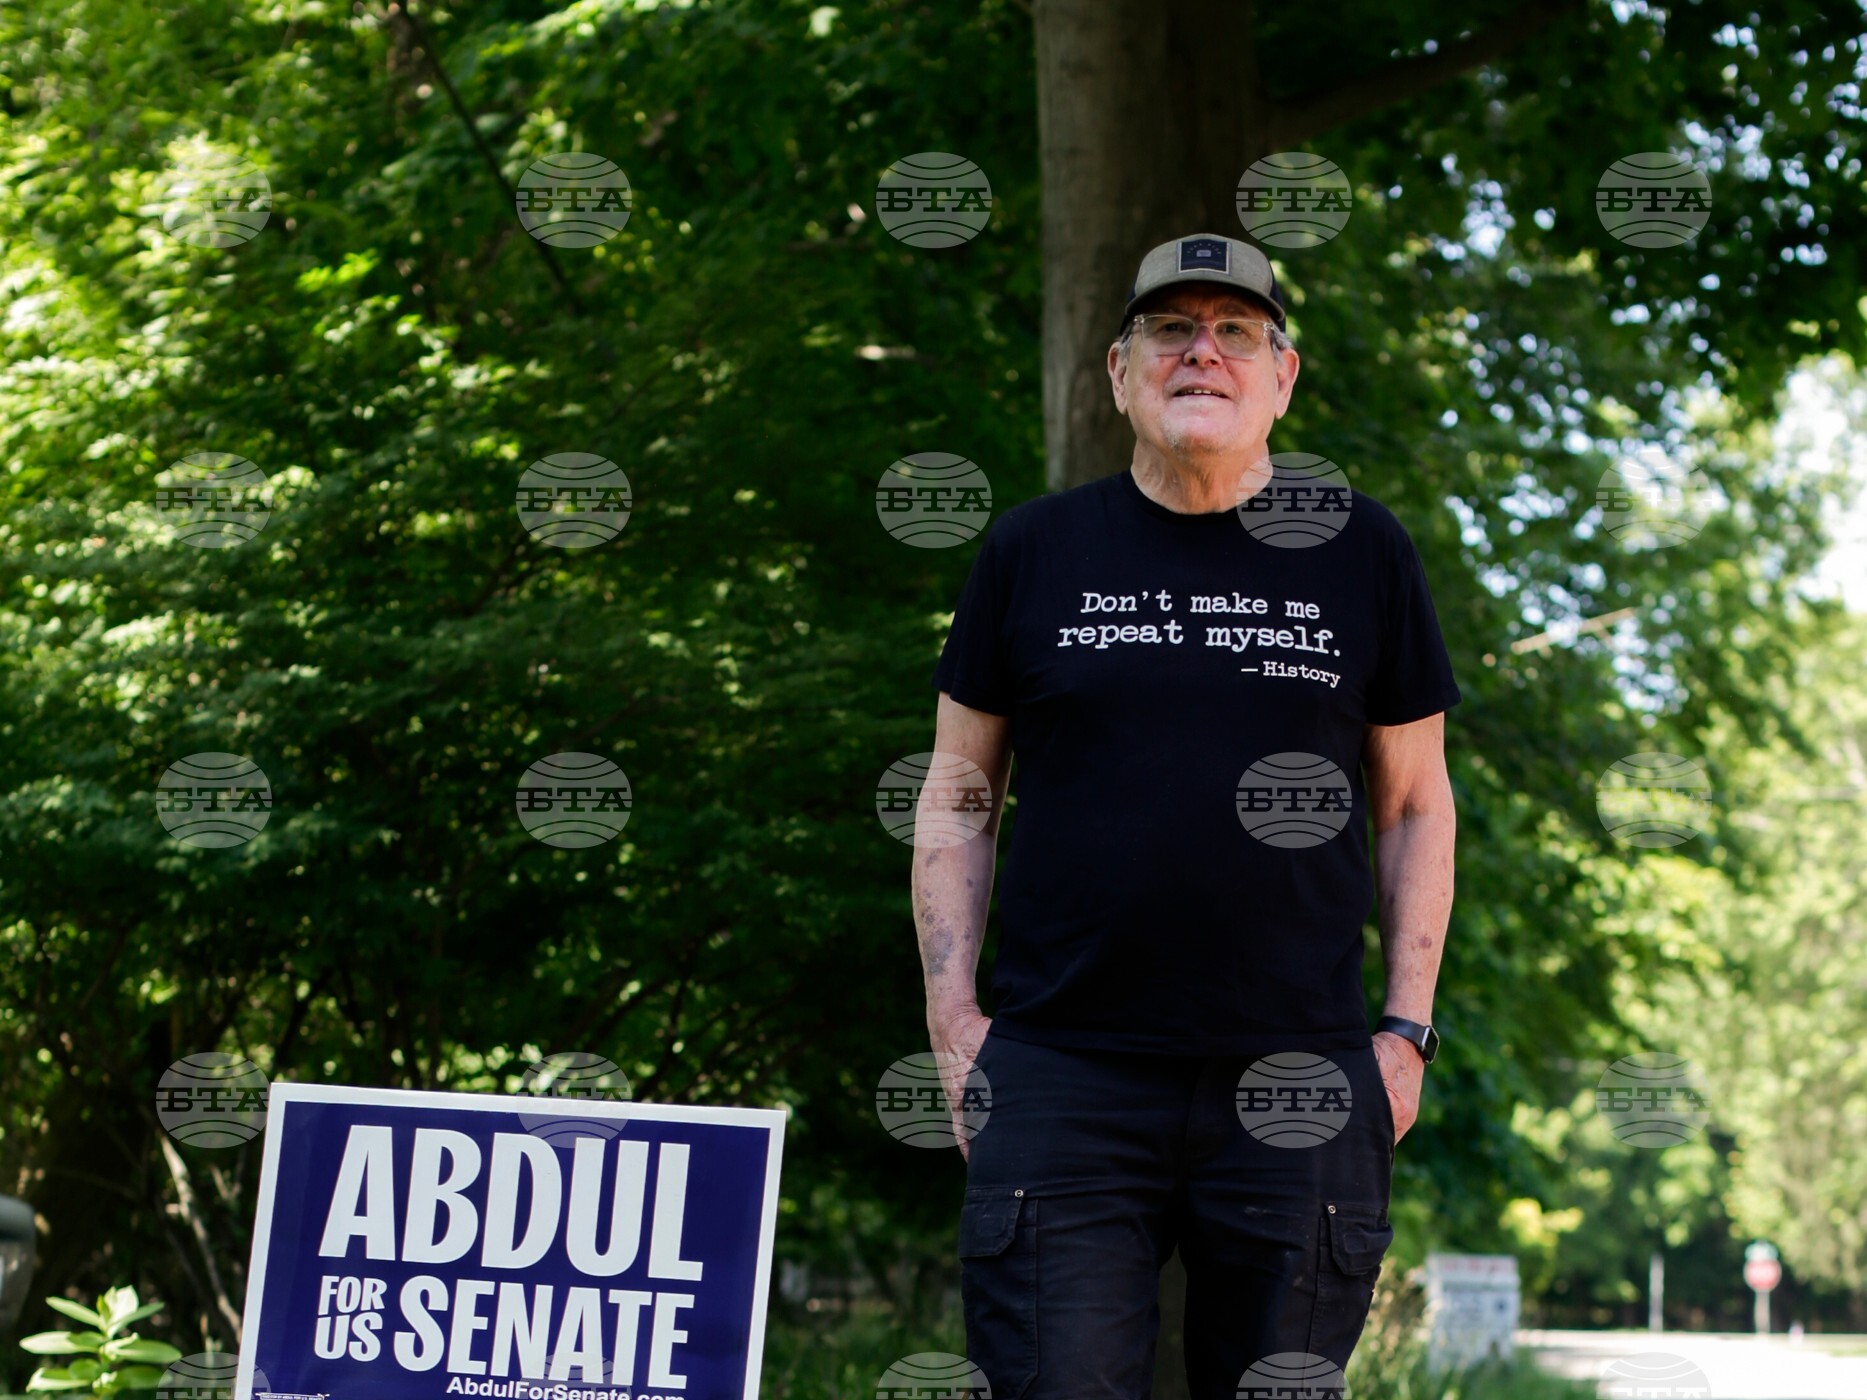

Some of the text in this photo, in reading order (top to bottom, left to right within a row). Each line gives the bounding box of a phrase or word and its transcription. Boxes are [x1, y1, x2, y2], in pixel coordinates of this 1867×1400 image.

[1080, 589, 1321, 620] Don’t make me
[1057, 619, 1341, 657] repeat myself.
[319, 1124, 704, 1282] ABDUL
[318, 1275, 388, 1315] FOR
[314, 1312, 383, 1362] US
[394, 1275, 695, 1390] SENATE
